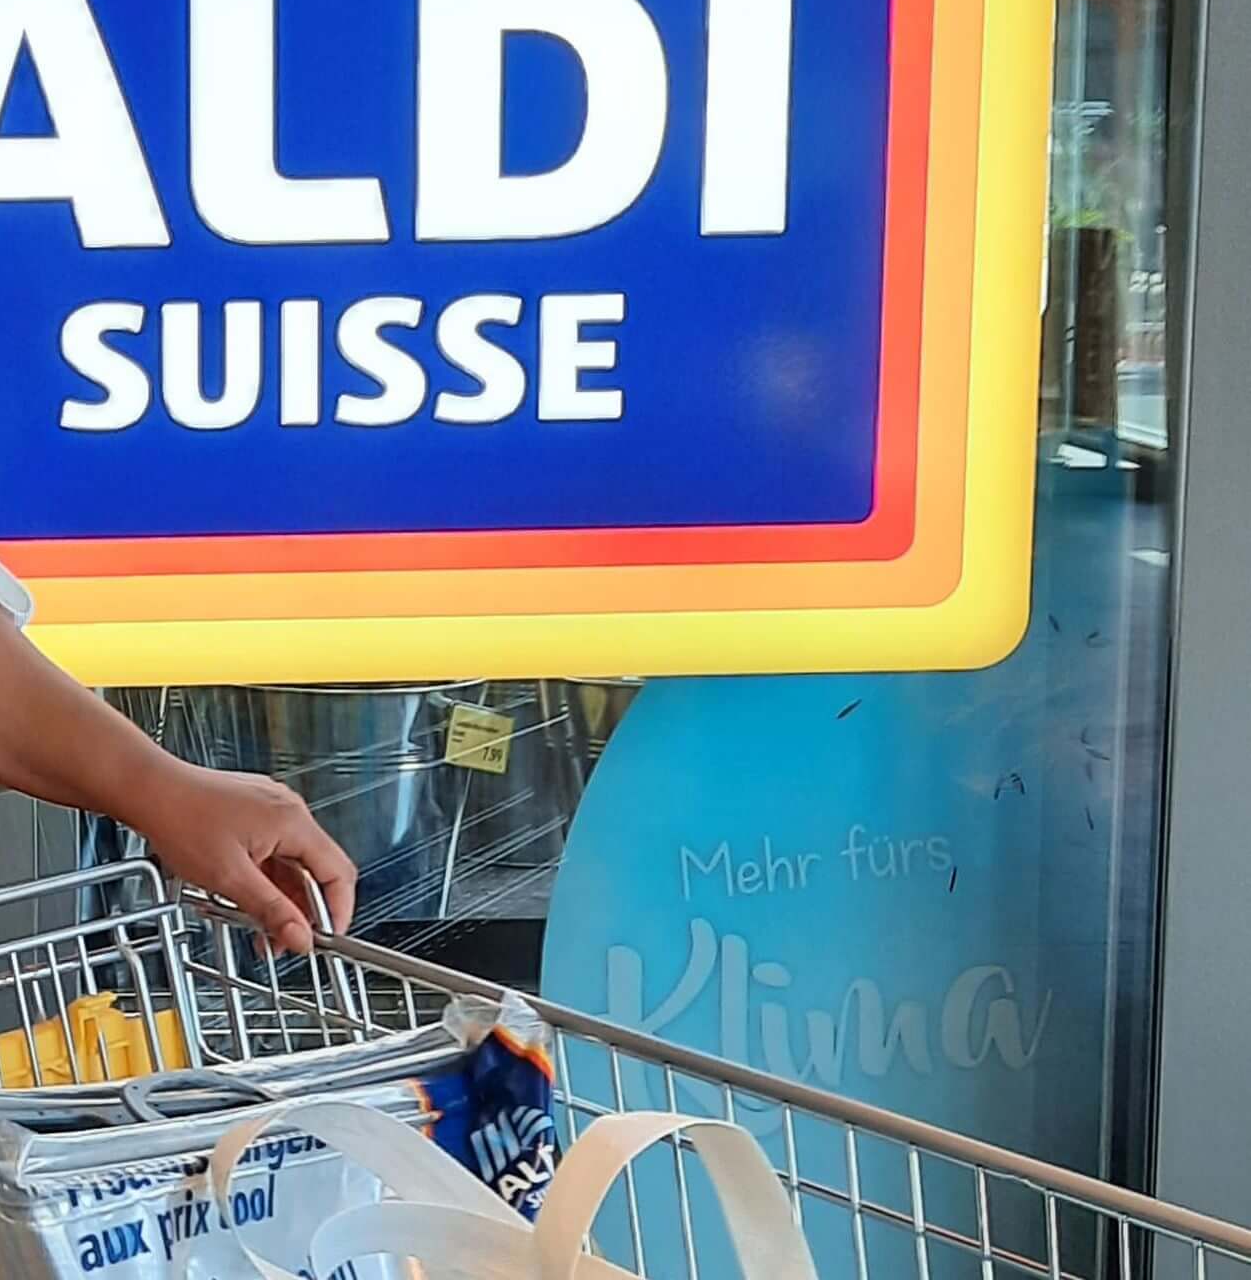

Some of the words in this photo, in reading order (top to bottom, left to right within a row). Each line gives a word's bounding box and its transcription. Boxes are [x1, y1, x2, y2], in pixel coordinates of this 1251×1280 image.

[58, 291, 626, 431] SUISSE
[679, 835, 822, 901] Mehr
[839, 824, 952, 883] fürs
[598, 916, 1052, 1137] Klima
[77, 1219, 152, 1272] aux
[156, 1189, 211, 1261] prix
